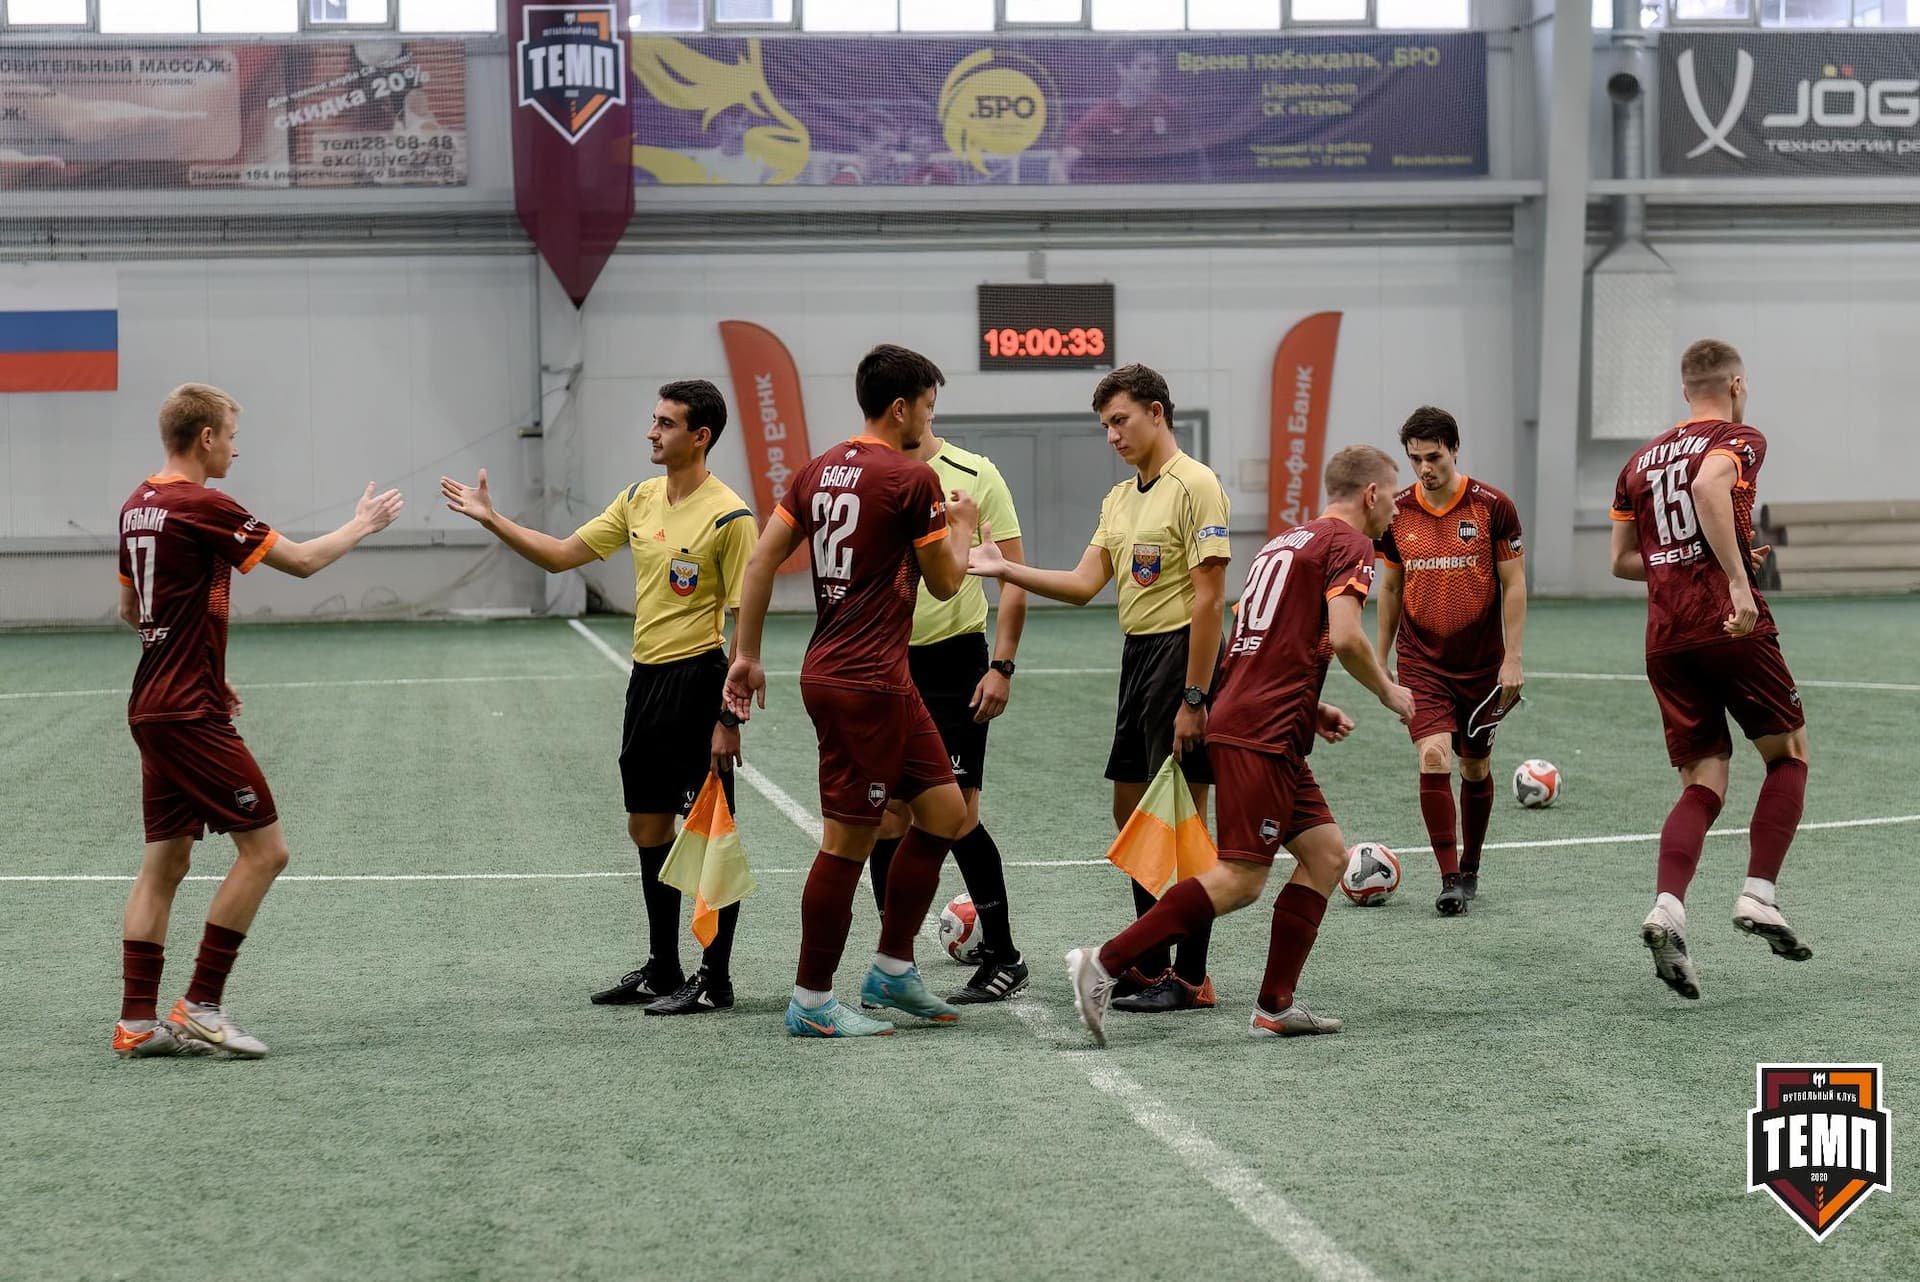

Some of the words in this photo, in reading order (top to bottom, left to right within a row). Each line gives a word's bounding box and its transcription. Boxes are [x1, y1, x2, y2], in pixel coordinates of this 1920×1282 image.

[139, 58, 233, 73] МАССАЖ:
[528, 44, 614, 91] ТЕМП
[1176, 52, 1248, 76] Время
[1253, 48, 1382, 70] побеждать,
[1389, 47, 1441, 67] .БРО
[274, 89, 366, 130] скидка
[371, 64, 431, 98] 20%
[969, 95, 1036, 119] .БРО
[983, 327, 1105, 357] 19:00:33
[1287, 365, 1314, 434] Банк
[820, 465, 862, 489] БАБИЧ
[1279, 438, 1309, 526] Альфа
[1646, 459, 1697, 546] 15
[811, 491, 861, 580] 22
[1649, 540, 1703, 566] SEUS
[126, 535, 156, 623] 17
[1235, 549, 1294, 638] 20
